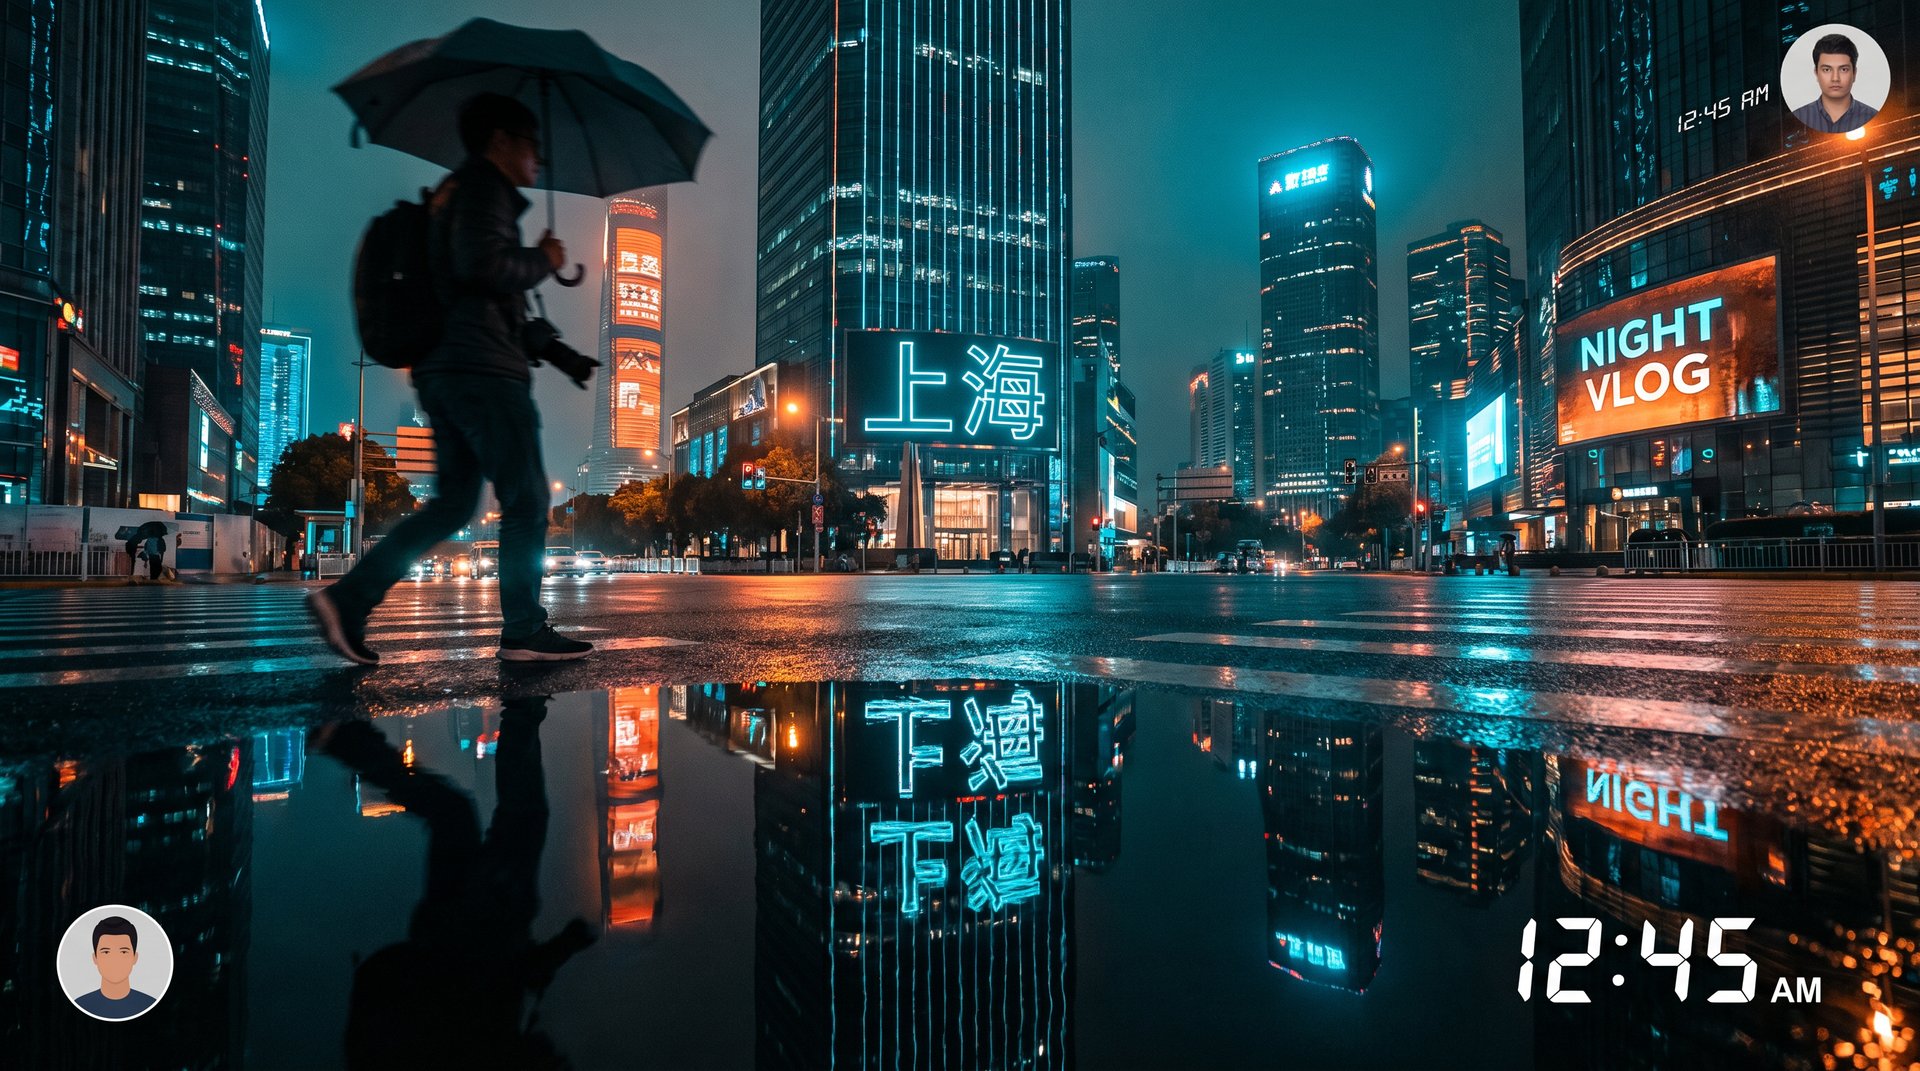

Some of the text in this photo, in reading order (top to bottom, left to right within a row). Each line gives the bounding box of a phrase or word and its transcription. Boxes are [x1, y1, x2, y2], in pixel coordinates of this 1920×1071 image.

[1581, 296, 1724, 372] NIGHT
[864, 341, 1046, 440] 上海
[1584, 352, 1711, 412] VLOG
